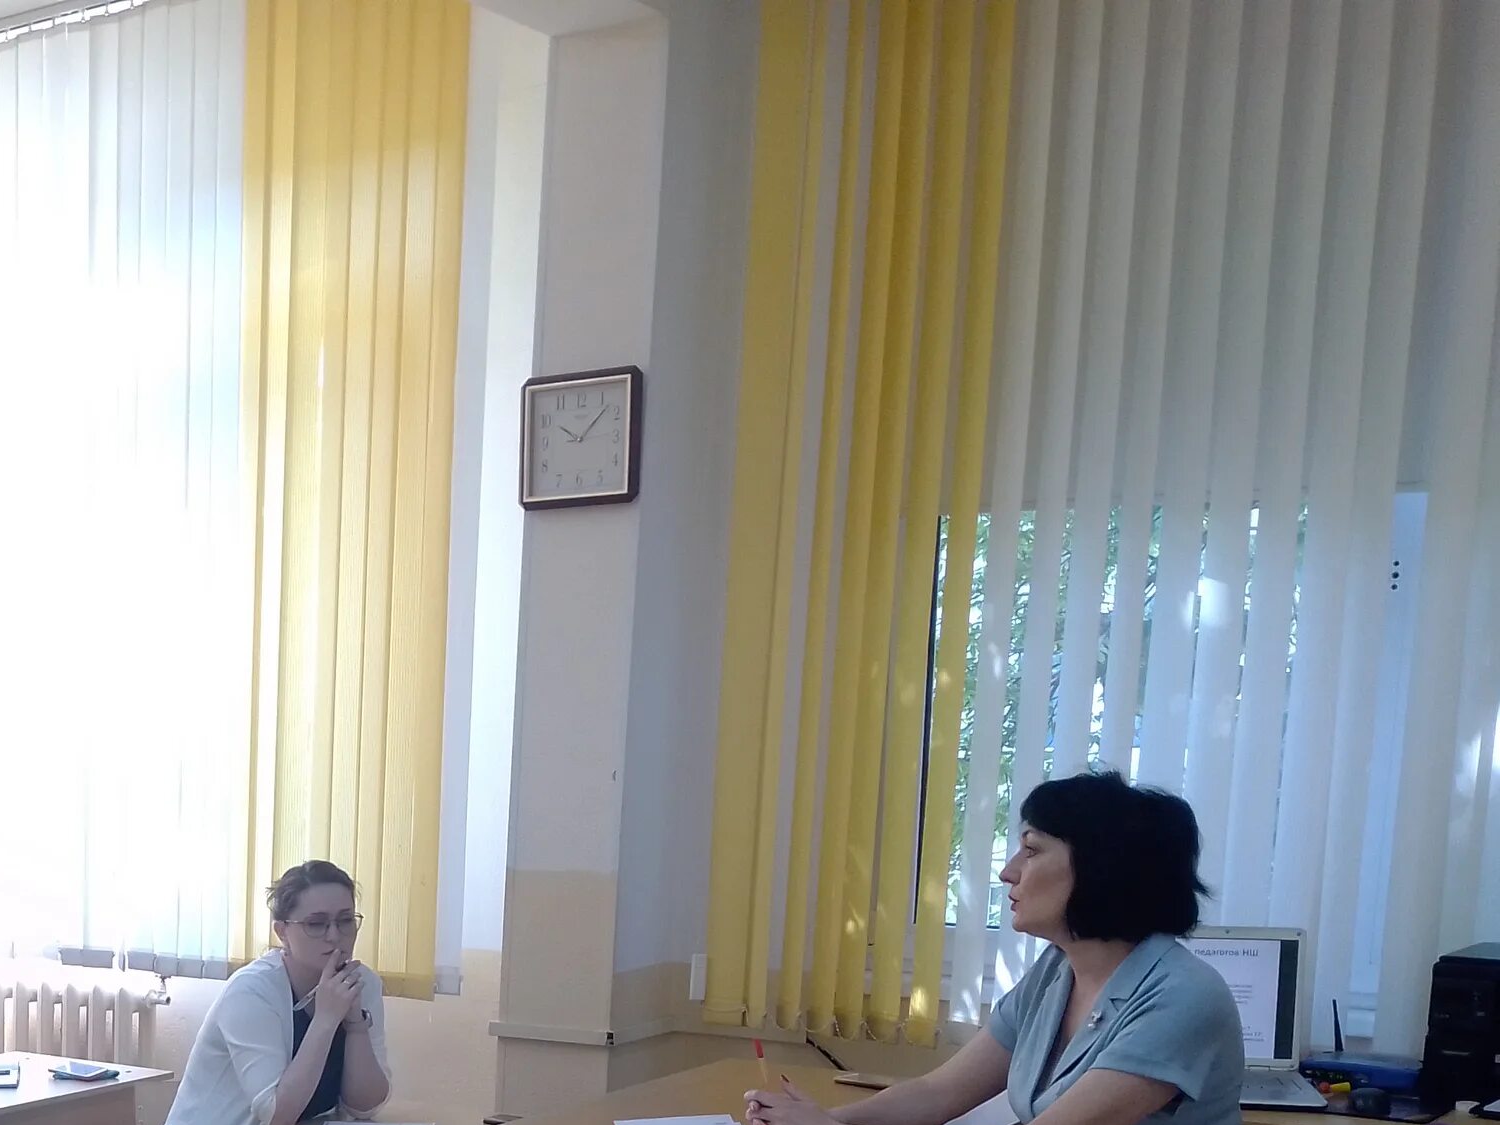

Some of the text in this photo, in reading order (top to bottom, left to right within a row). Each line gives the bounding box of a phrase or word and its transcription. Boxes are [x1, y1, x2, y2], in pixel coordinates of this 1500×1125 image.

[556, 391, 587, 411] 11 12
[613, 405, 621, 420] 2
[541, 414, 552, 429] 10
[542, 437, 549, 451] 9
[613, 430, 620, 444] 3
[541, 459, 548, 473] 8
[612, 453, 618, 467] 4
[556, 474, 563, 488] 7
[576, 473, 583, 488] 6
